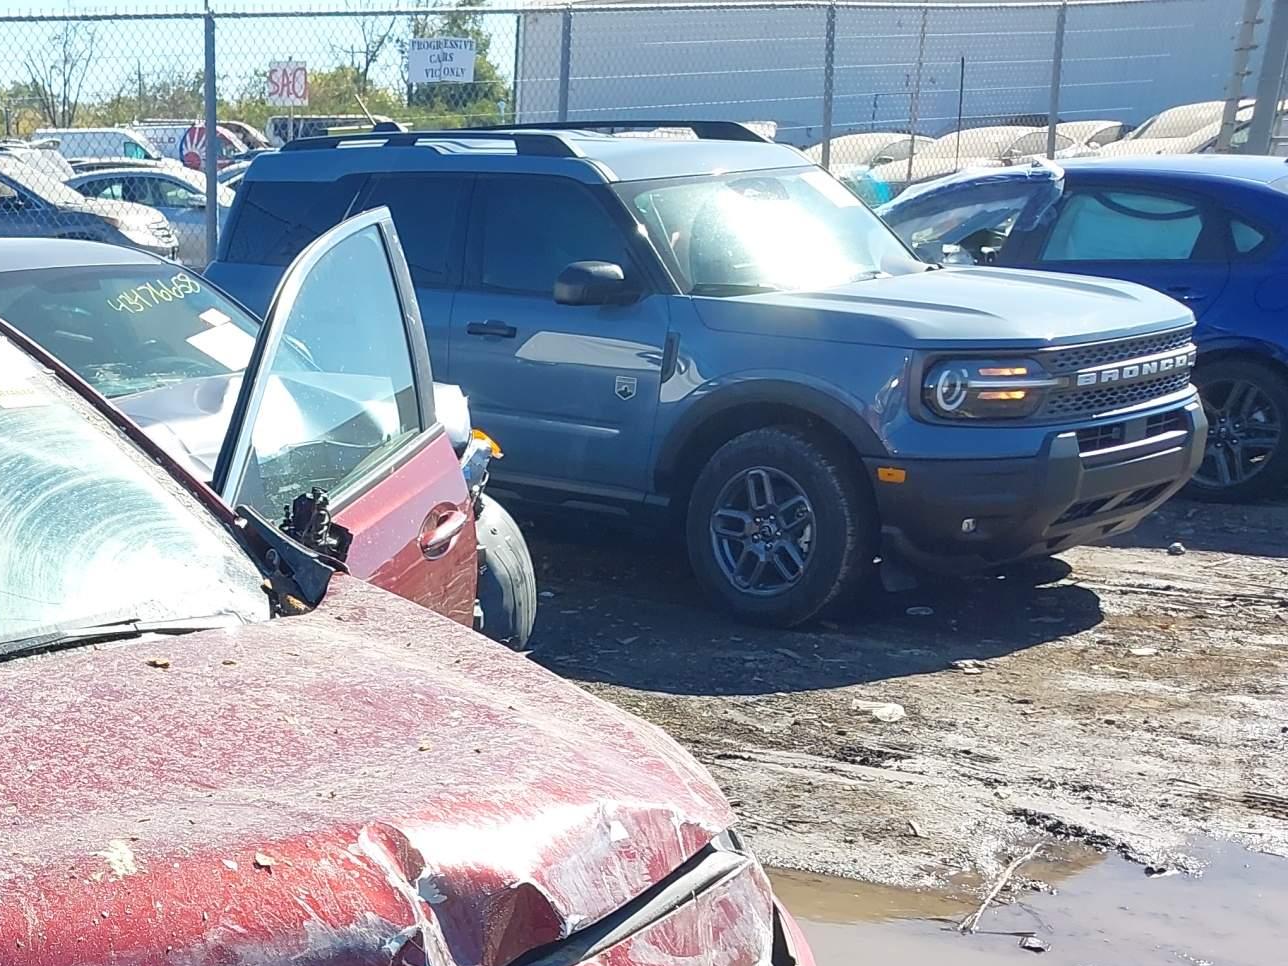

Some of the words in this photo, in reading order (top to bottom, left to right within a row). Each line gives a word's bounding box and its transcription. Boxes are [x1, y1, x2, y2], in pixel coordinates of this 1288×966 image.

[411, 39, 475, 51] PROGRESSIVE
[429, 52, 454, 64] CARS
[443, 66, 466, 78] ONLY
[1077, 354, 1188, 386] BRONCO
